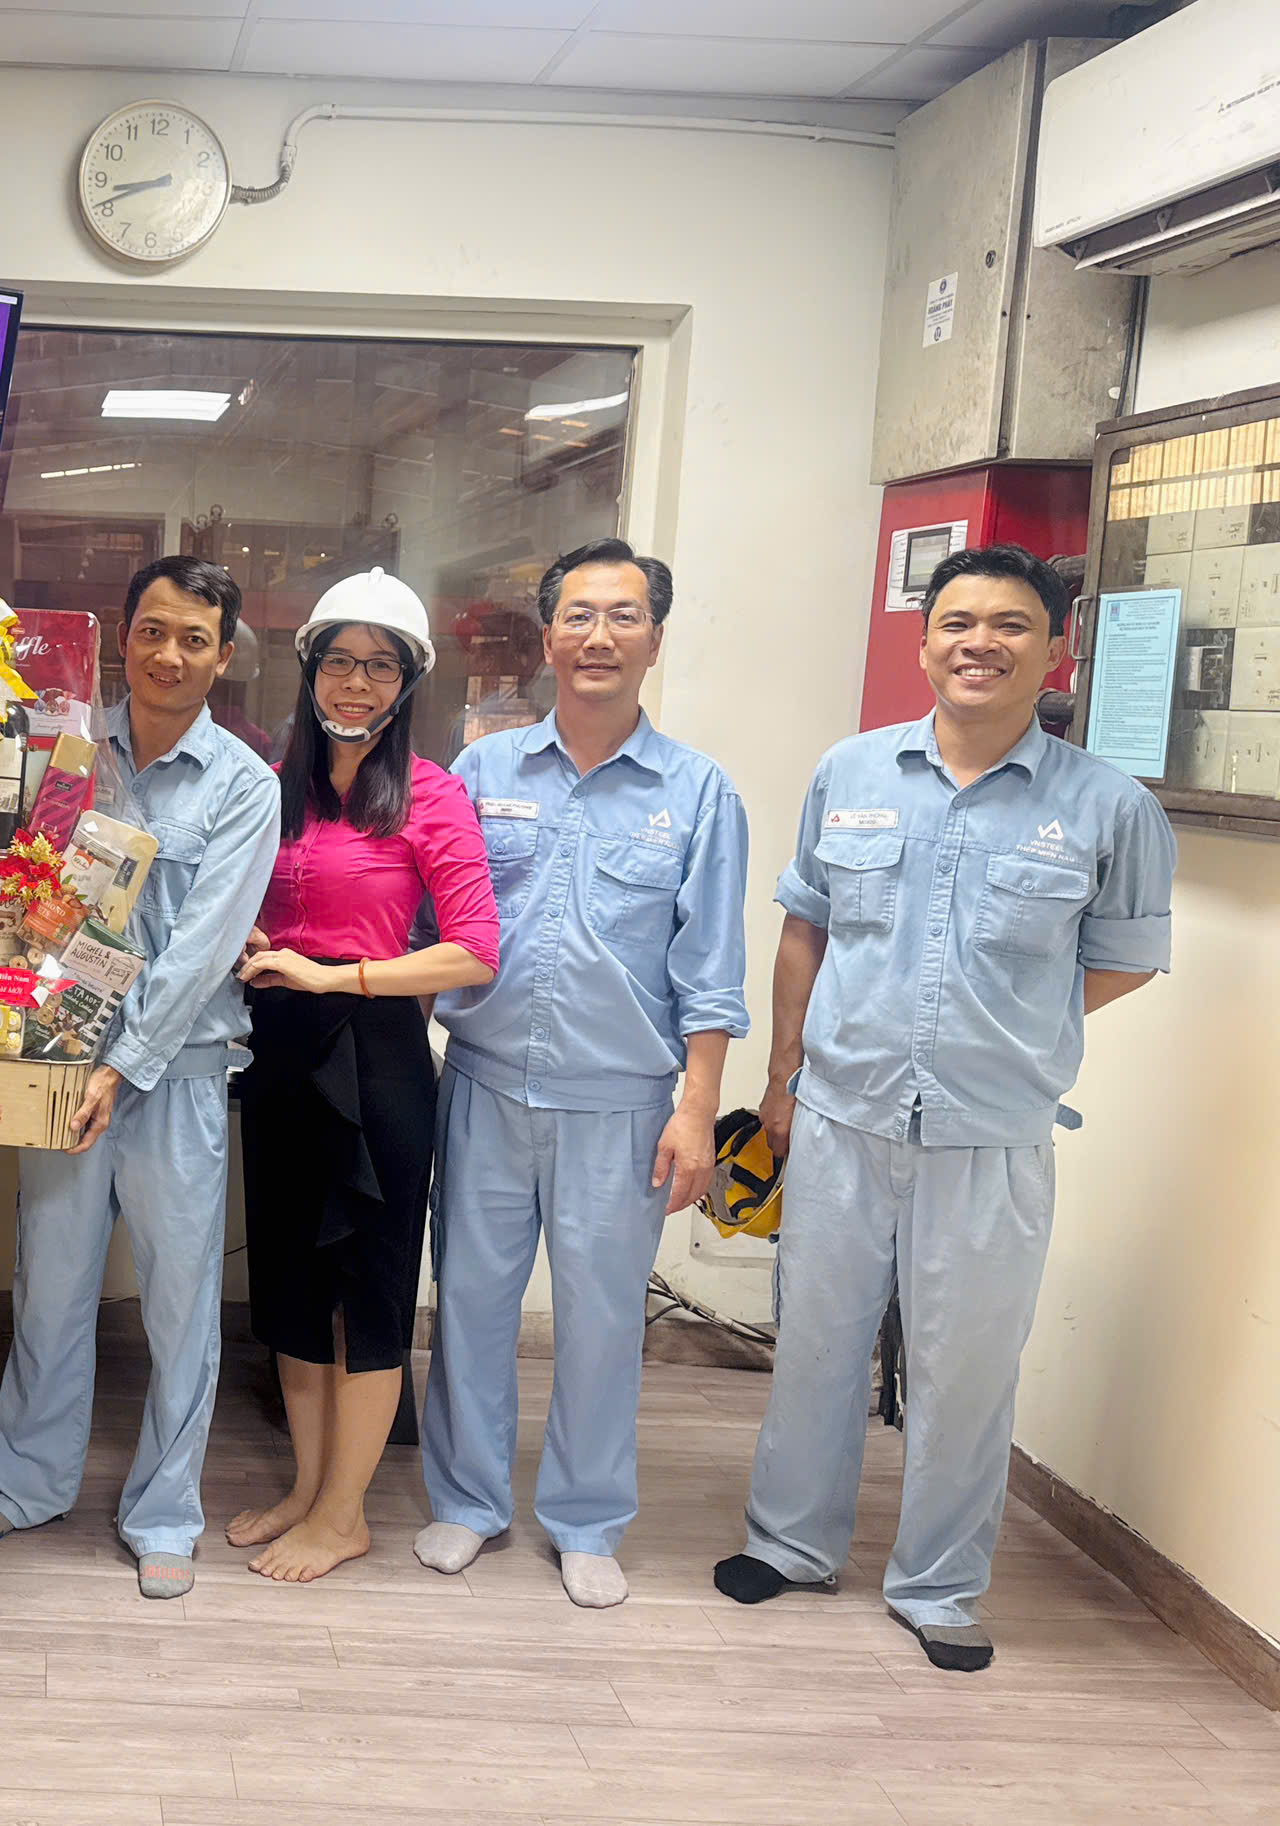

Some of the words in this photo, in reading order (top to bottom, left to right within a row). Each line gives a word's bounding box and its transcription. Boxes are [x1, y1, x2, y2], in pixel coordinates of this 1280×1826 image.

[127, 124, 139, 141] 11
[150, 118, 170, 136] 12
[184, 128, 191, 145] 1
[104, 143, 124, 161] 10
[197, 151, 210, 168] 2
[95, 171, 108, 188] 9
[101, 200, 114, 217] 8
[119, 222, 132, 238] 7
[144, 232, 157, 249] 6
[71, 948, 107, 968] AUGUSTIN
[78, 941, 102, 957] MICHEL
[105, 951, 111, 959] &
[14, 974, 30, 983] Nam
